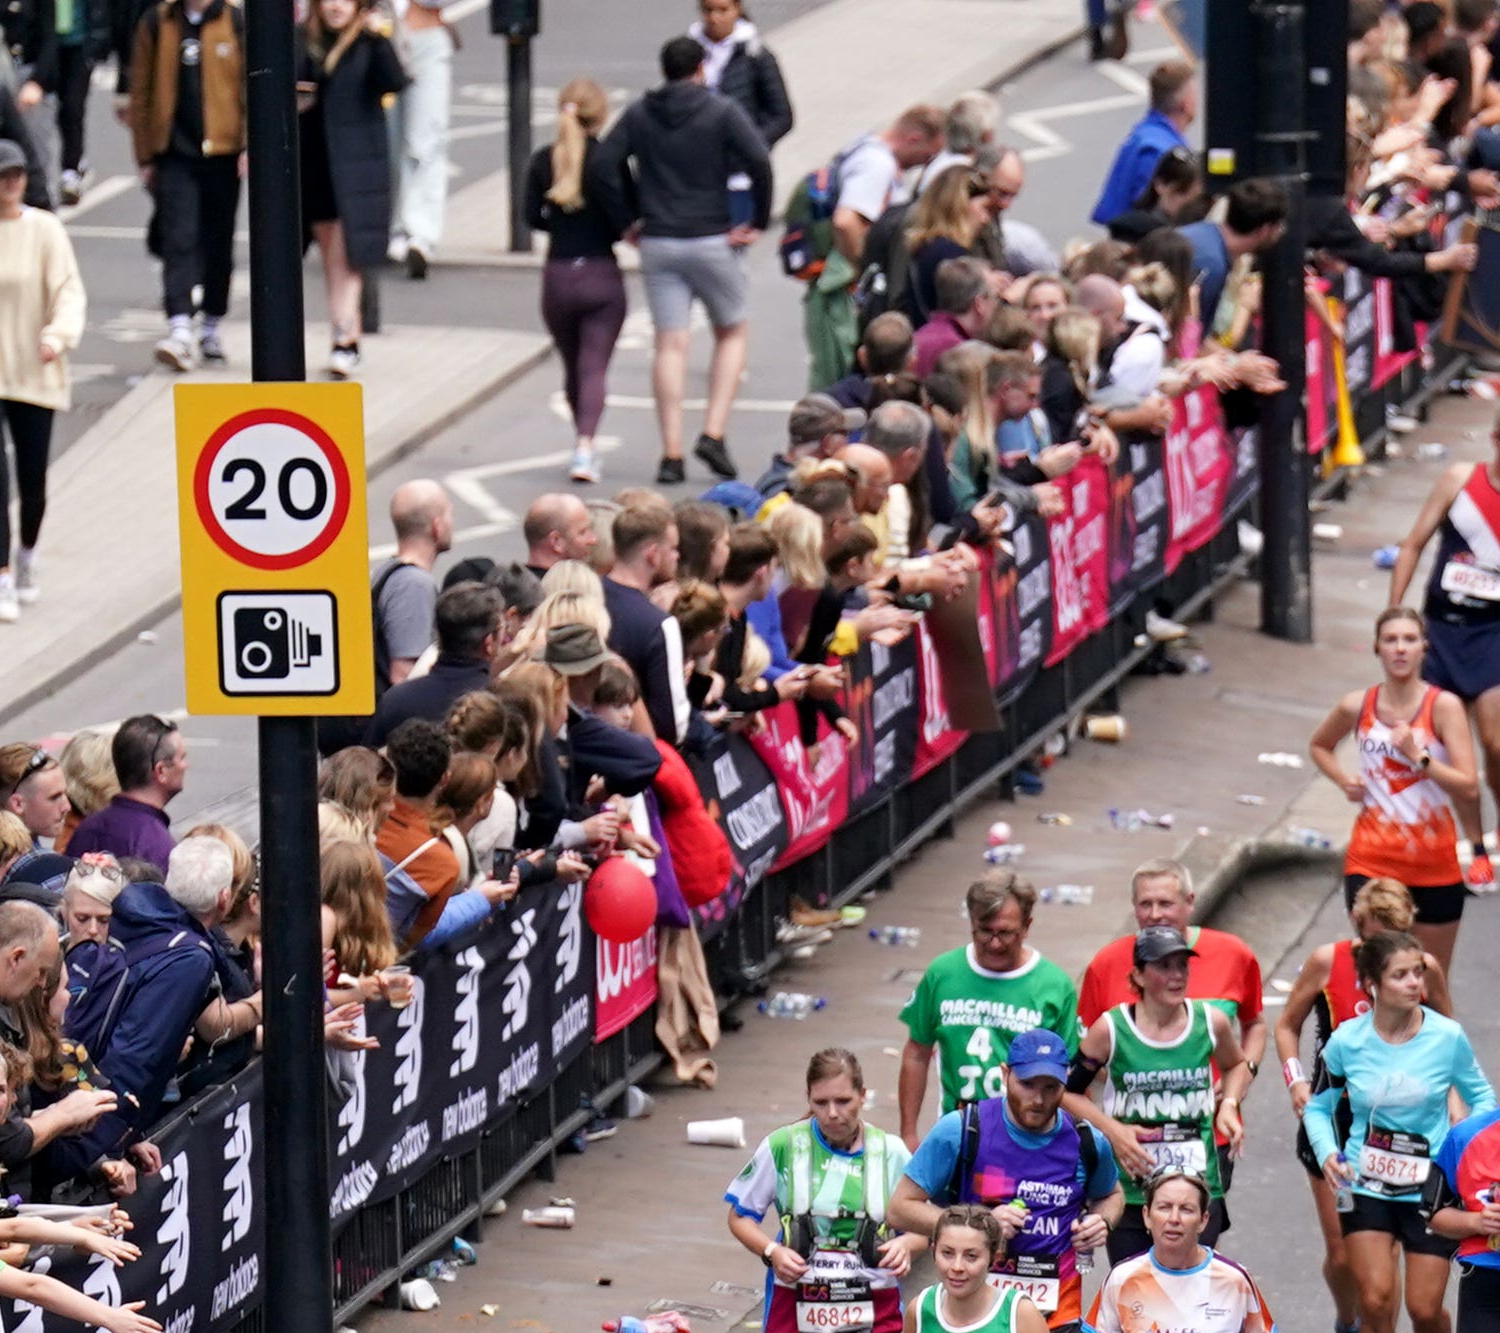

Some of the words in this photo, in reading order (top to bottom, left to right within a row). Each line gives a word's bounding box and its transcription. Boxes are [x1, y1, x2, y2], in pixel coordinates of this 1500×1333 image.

[221, 457, 328, 520] 20
[939, 998, 1043, 1025] MACMILLAN
[966, 1027, 992, 1057] 4
[1366, 1152, 1420, 1180] 35674
[806, 1304, 862, 1326] 46842
